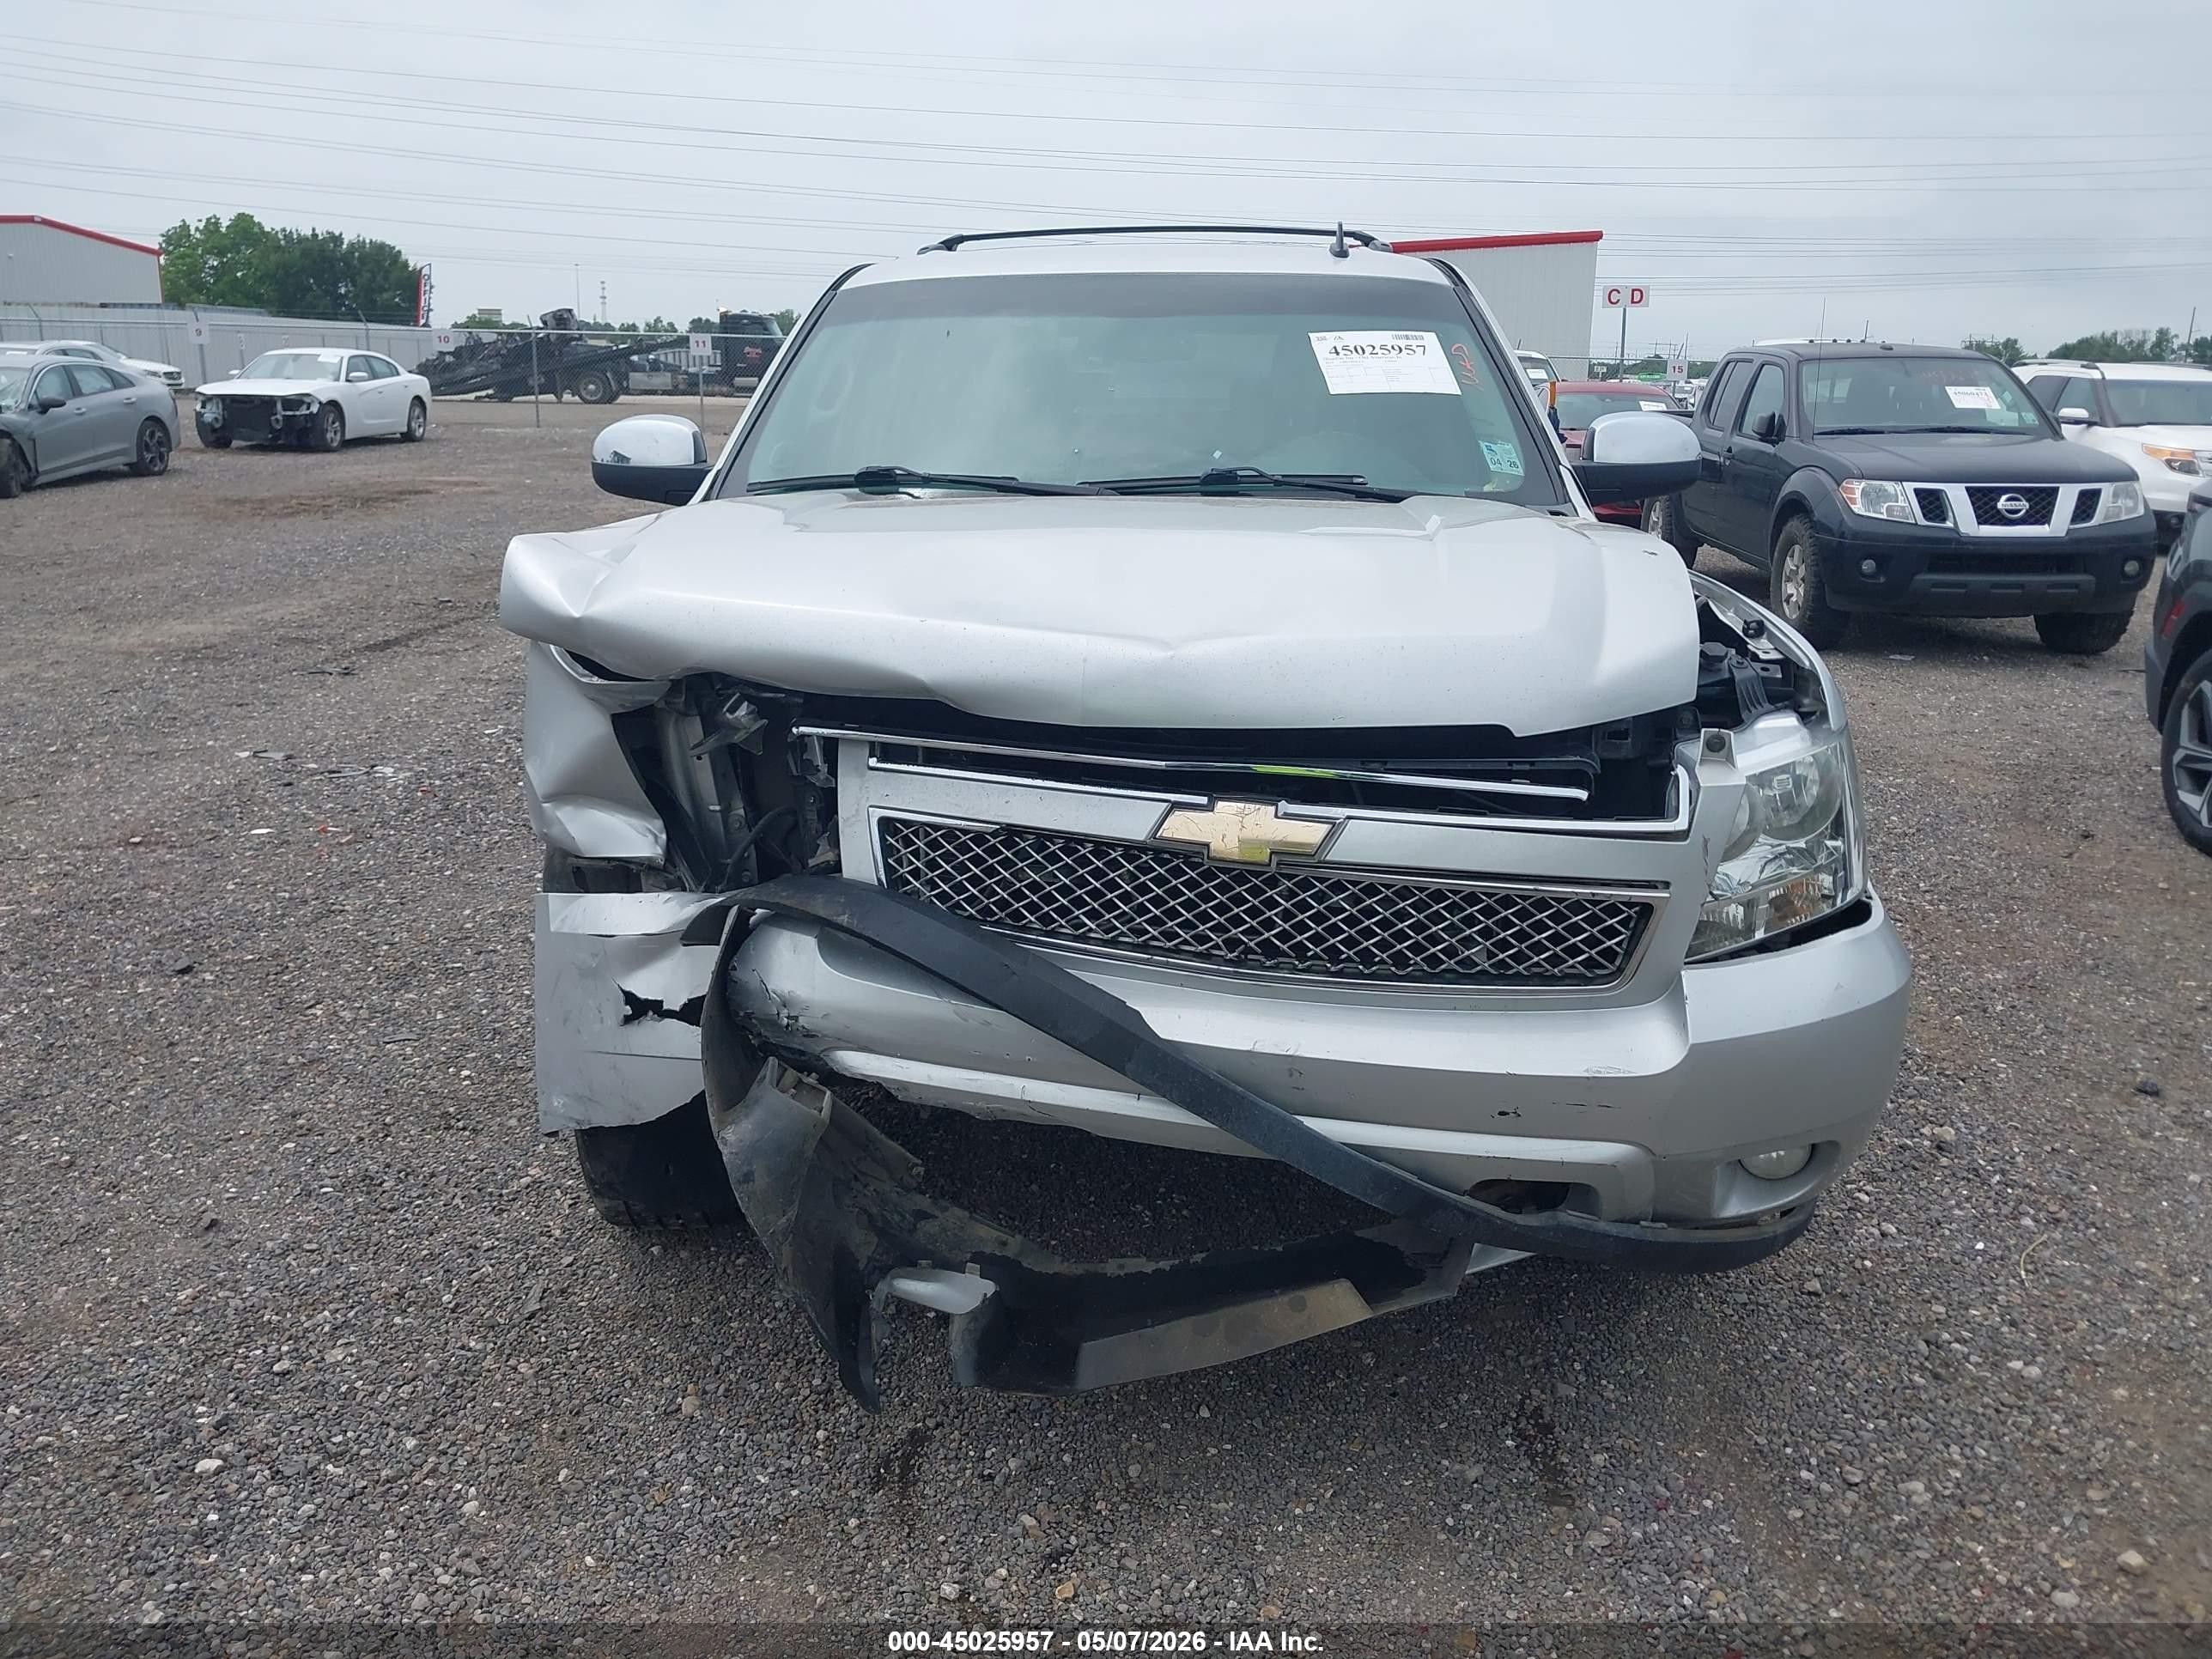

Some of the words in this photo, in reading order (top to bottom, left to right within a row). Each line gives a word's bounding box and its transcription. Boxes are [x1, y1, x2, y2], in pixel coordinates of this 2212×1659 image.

[1607, 289, 1620, 305] C
[1631, 288, 1644, 305] D
[195, 328, 203, 337] 9
[437, 335, 450, 344] 10
[1328, 344, 1426, 356] 45025957
[1671, 365, 1684, 374] 15
[1490, 457, 1502, 466] 04
